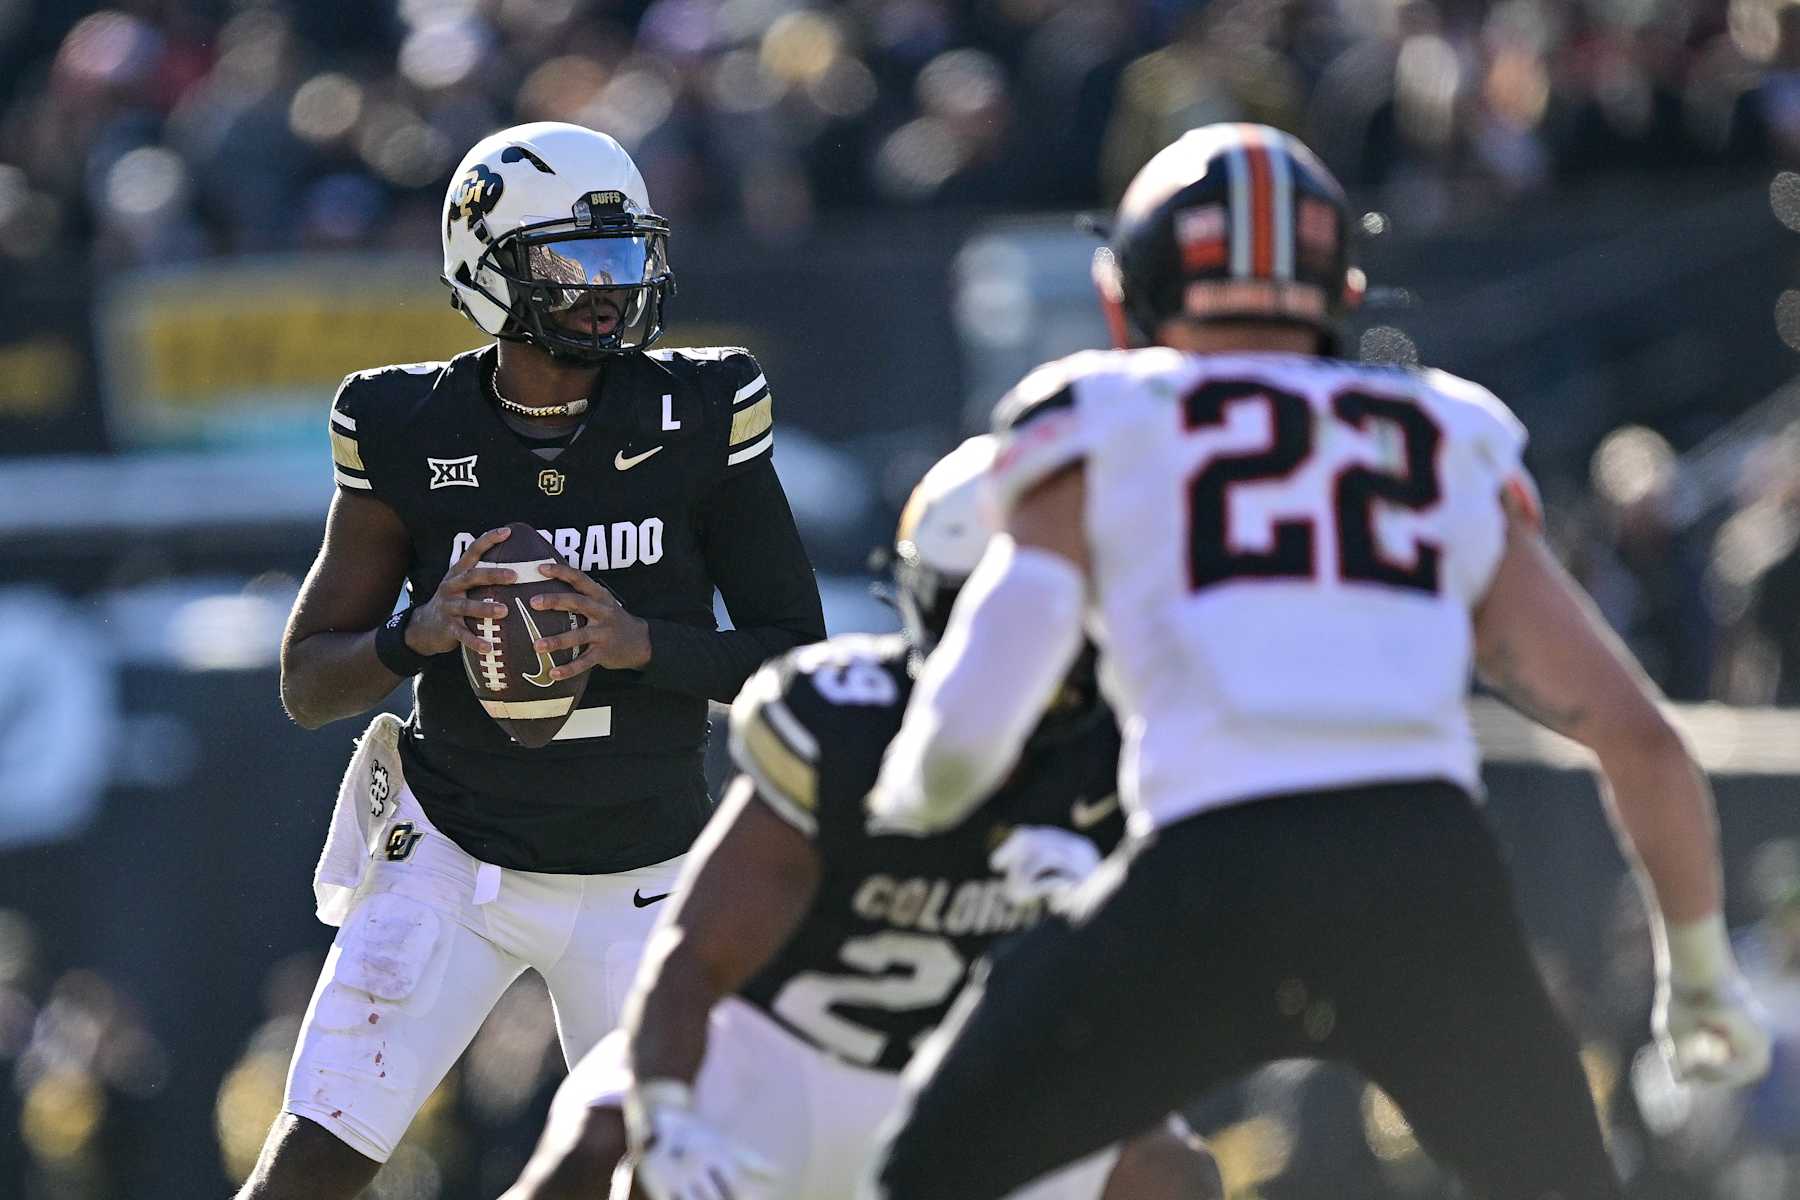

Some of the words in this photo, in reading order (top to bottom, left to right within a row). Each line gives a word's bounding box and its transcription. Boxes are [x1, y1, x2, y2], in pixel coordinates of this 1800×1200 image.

[591, 192, 621, 205] BUFFS
[662, 394, 681, 431] L
[538, 469, 565, 495] CU
[1178, 377, 1443, 602] 22
[450, 517, 664, 571] CRADO
